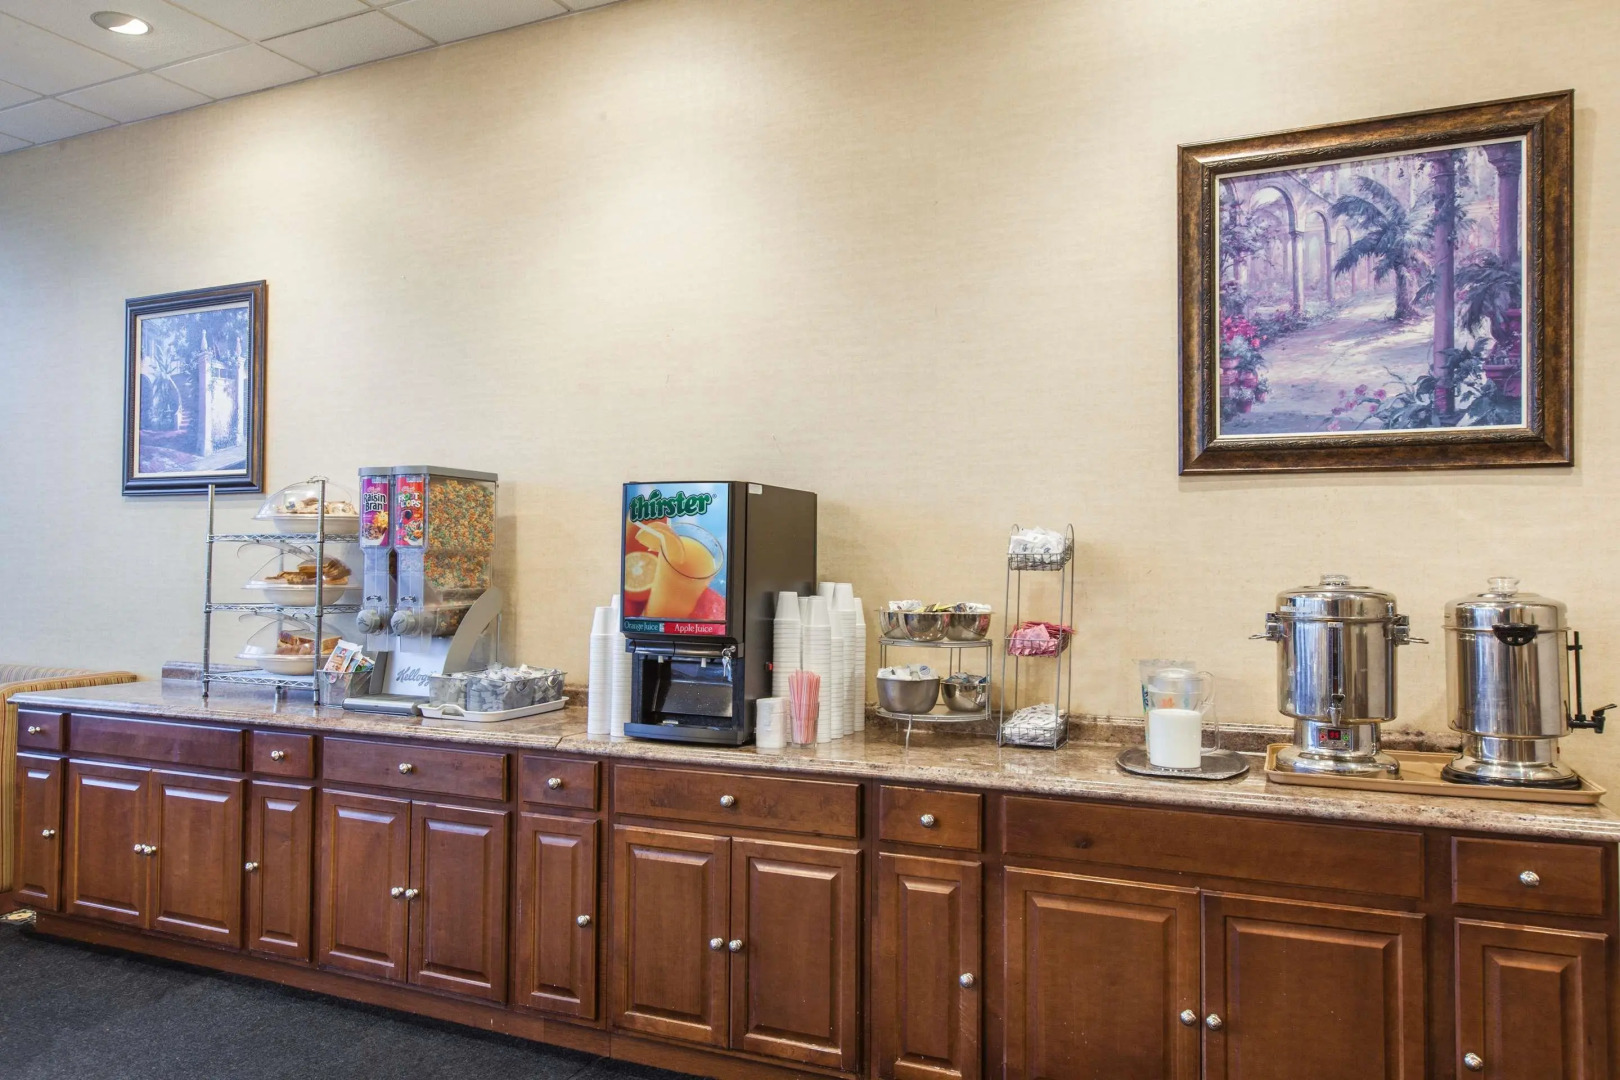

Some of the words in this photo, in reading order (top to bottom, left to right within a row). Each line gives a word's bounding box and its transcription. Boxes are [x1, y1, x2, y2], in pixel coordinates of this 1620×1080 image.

[364, 492, 386, 504] Raisin
[401, 499, 422, 508] LOOPS
[365, 502, 383, 512] Bran
[629, 489, 712, 522] thirster
[624, 621, 644, 632] Orange
[644, 622, 658, 632] Juice
[674, 623, 695, 633] Apple
[695, 623, 713, 634] Juice
